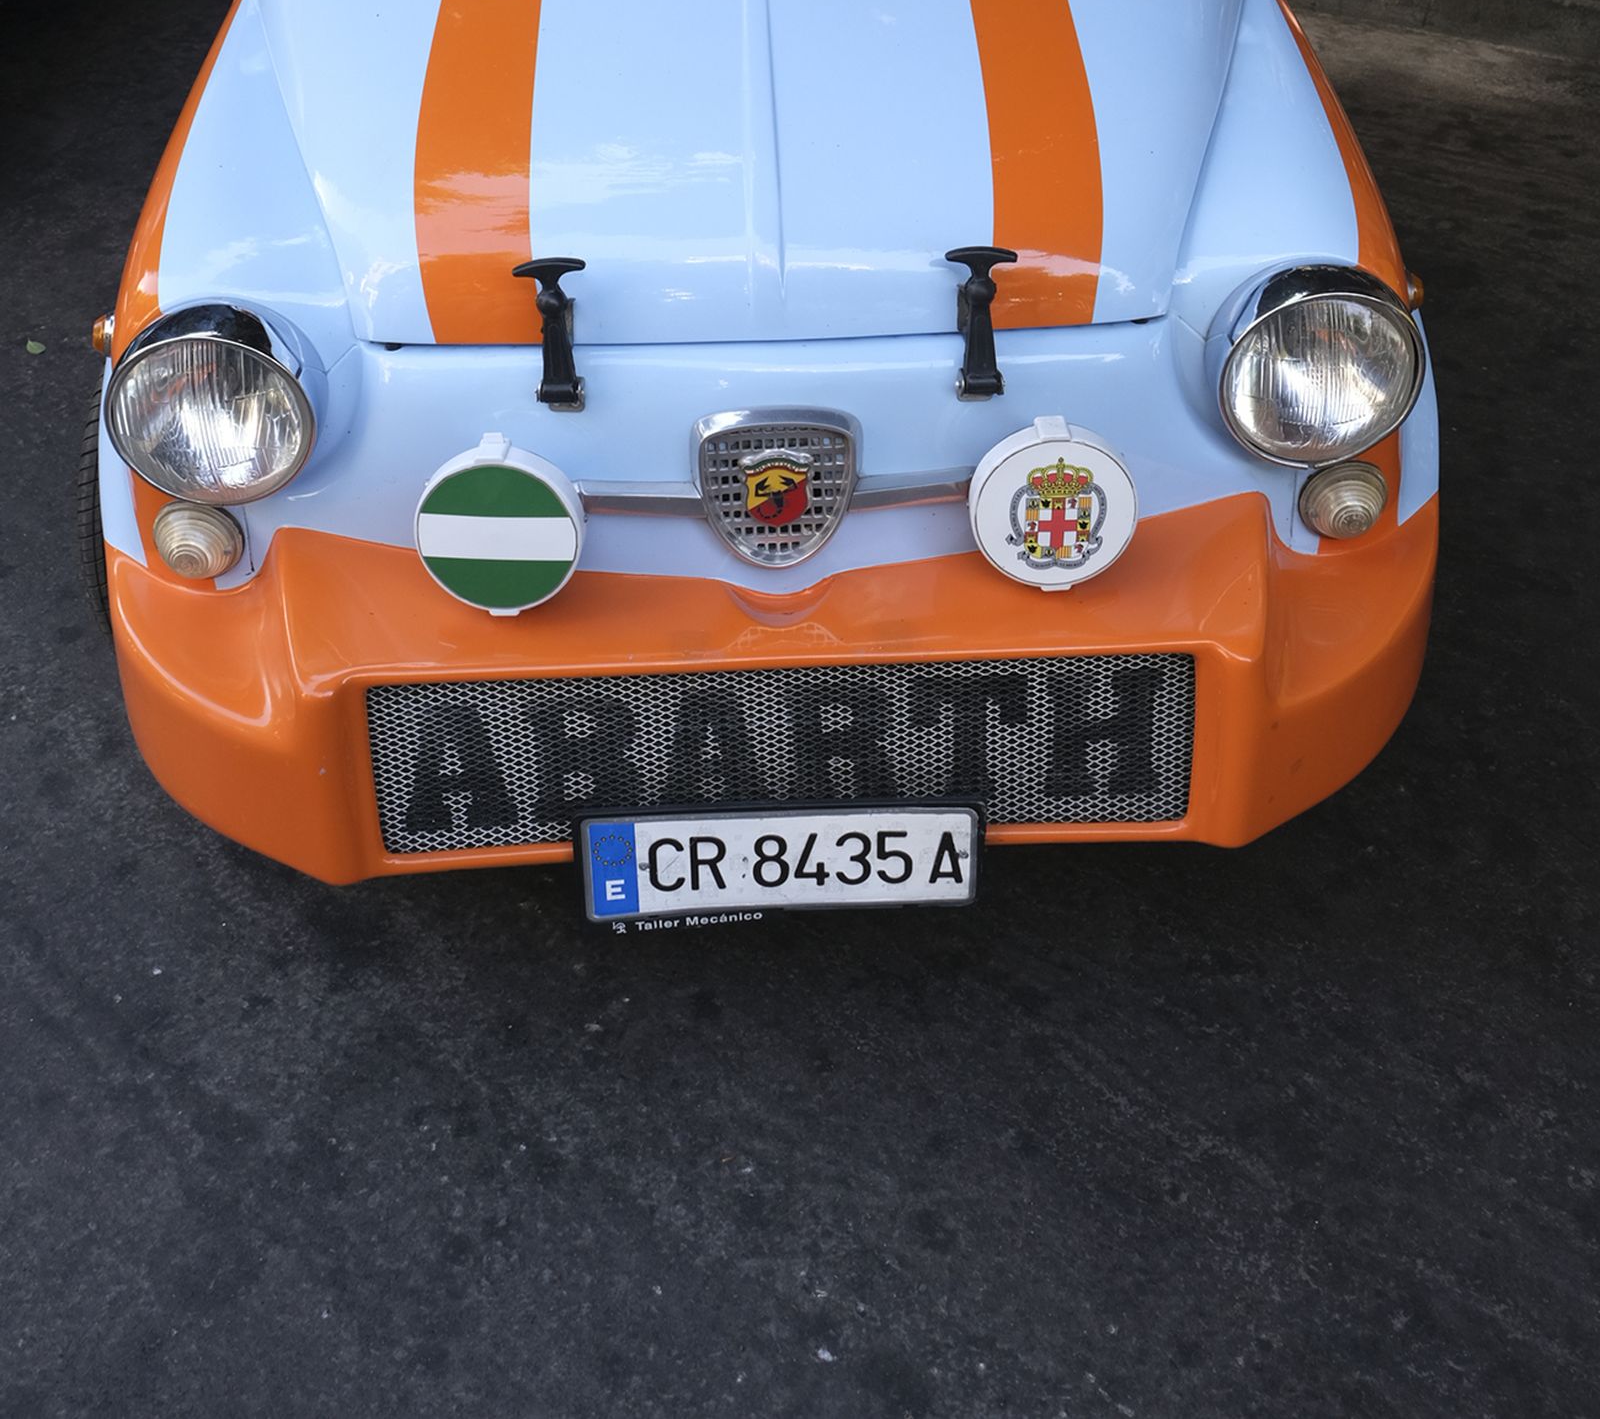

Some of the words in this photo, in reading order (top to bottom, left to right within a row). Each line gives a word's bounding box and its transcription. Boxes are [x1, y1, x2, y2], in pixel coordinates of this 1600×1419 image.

[405, 668, 1162, 834] ABARTH
[648, 835, 727, 892] CR
[752, 831, 914, 888] 8435
[929, 831, 964, 884] A
[605, 879, 626, 901] E
[635, 919, 681, 931] Taller
[686, 911, 764, 926] Mecánico
